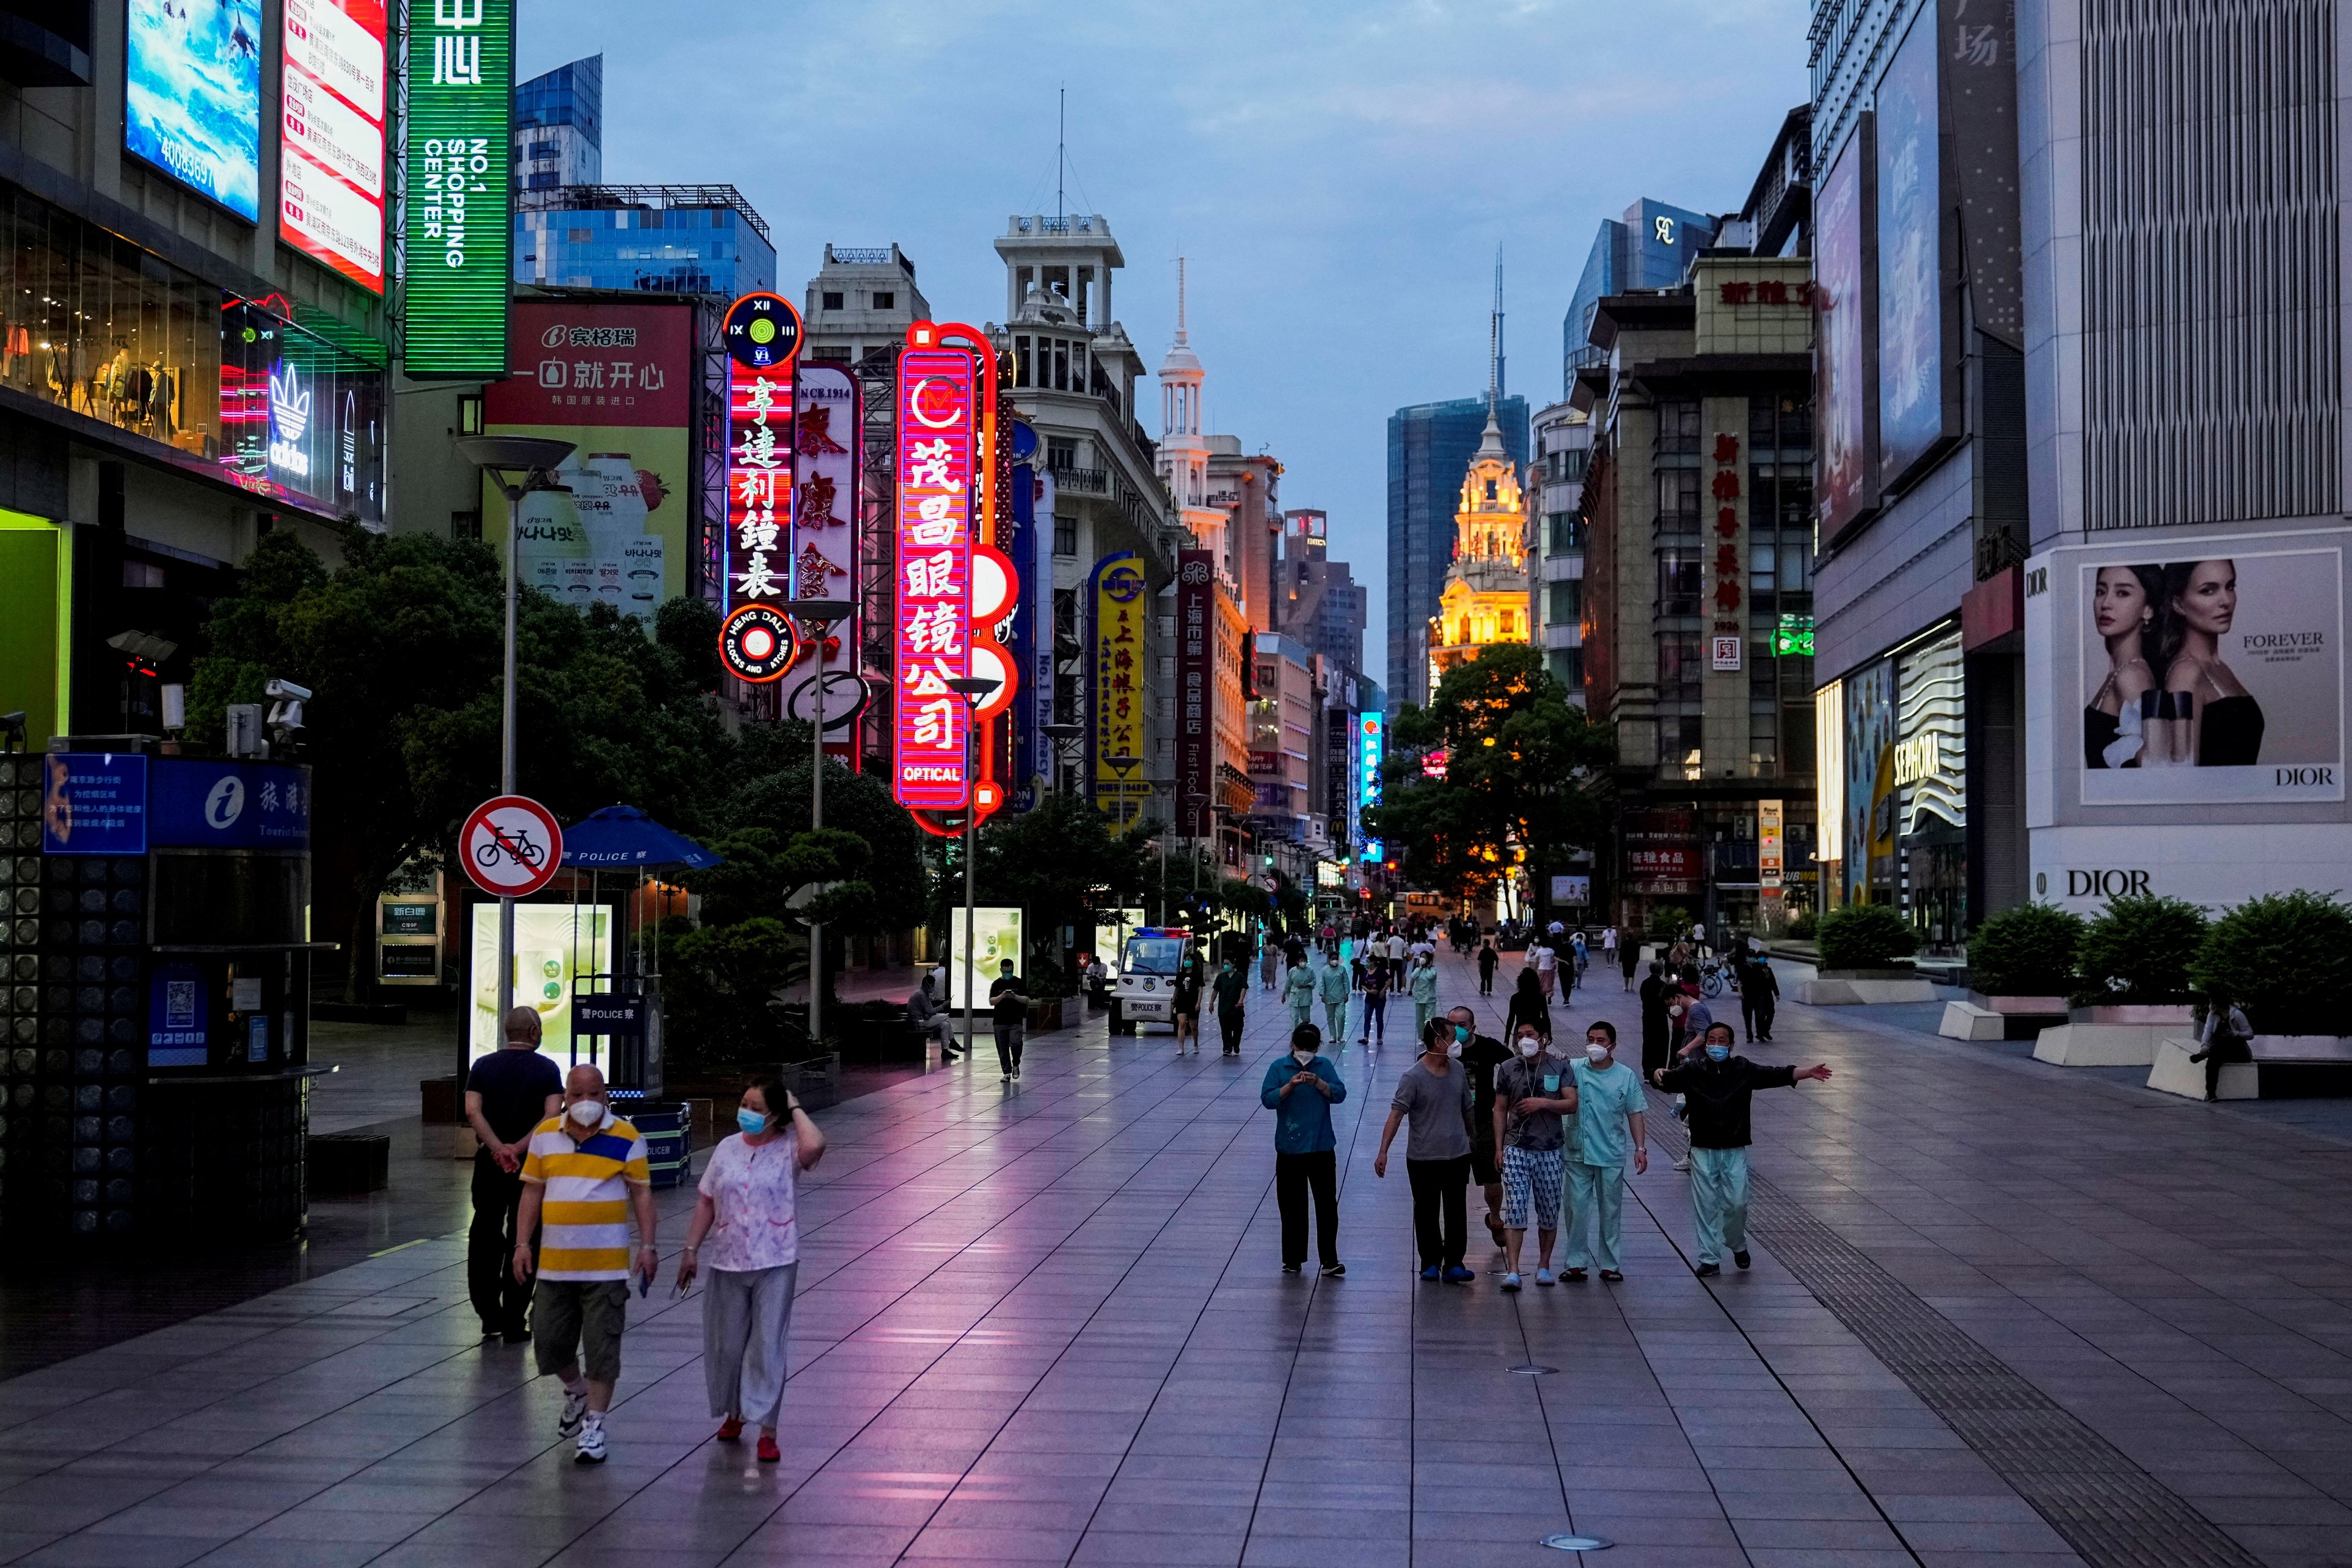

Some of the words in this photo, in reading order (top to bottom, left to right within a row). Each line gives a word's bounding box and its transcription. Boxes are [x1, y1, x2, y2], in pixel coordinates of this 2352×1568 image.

[433, 0, 482, 84] 中心
[309, 32, 374, 94] 黄浦区南京东路830号第一百货
[288, 73, 313, 104] 世茂广场店
[307, 126, 377, 186] 黄浦区南京东路世茂广场西区8楼
[470, 139, 488, 192] NO.1
[286, 158, 302, 181] 外滩店
[424, 139, 443, 239] CENTER
[446, 139, 466, 268] SHOPPING
[306, 212, 380, 269] 黄浦区南京东路123号外滩中央5楼
[754, 301, 770, 310] XII
[569, 326, 637, 348] 宾格瑞
[730, 324, 743, 335] IX
[782, 326, 794, 336] III
[552, 395, 635, 406] 韩国原装进口
[800, 388, 850, 398] NCE.1914
[271, 440, 308, 475] adidas
[625, 549, 662, 558] 바나나맛
[904, 437, 962, 749] 茂昌眼镜公司
[2026, 566, 2048, 598] DIOR
[729, 611, 757, 636] HENG
[762, 611, 787, 635] DALI
[2243, 632, 2324, 648] FOREVER
[727, 639, 745, 669] CLOCKS
[745, 665, 762, 674] AND
[1186, 593, 1203, 735] 上海市第一食品商店
[1039, 699, 1050, 776] Phamacy
[1187, 743, 1199, 768] First
[1894, 731, 1940, 787] SEPHORA
[903, 765, 960, 782] OPTICAL
[2276, 766, 2336, 787] DIOR
[1187, 771, 1199, 826] Foohall
[579, 851, 629, 861] POLICE
[1783, 870, 1819, 881] UBWA
[2066, 869, 2150, 897] DIOR
[394, 907, 426, 916] 新白鹿
[582, 1008, 591, 1019] 警
[591, 1010, 623, 1019] POLICE
[624, 1008, 634, 1019] 察
[648, 1146, 666, 1154] OLICE
